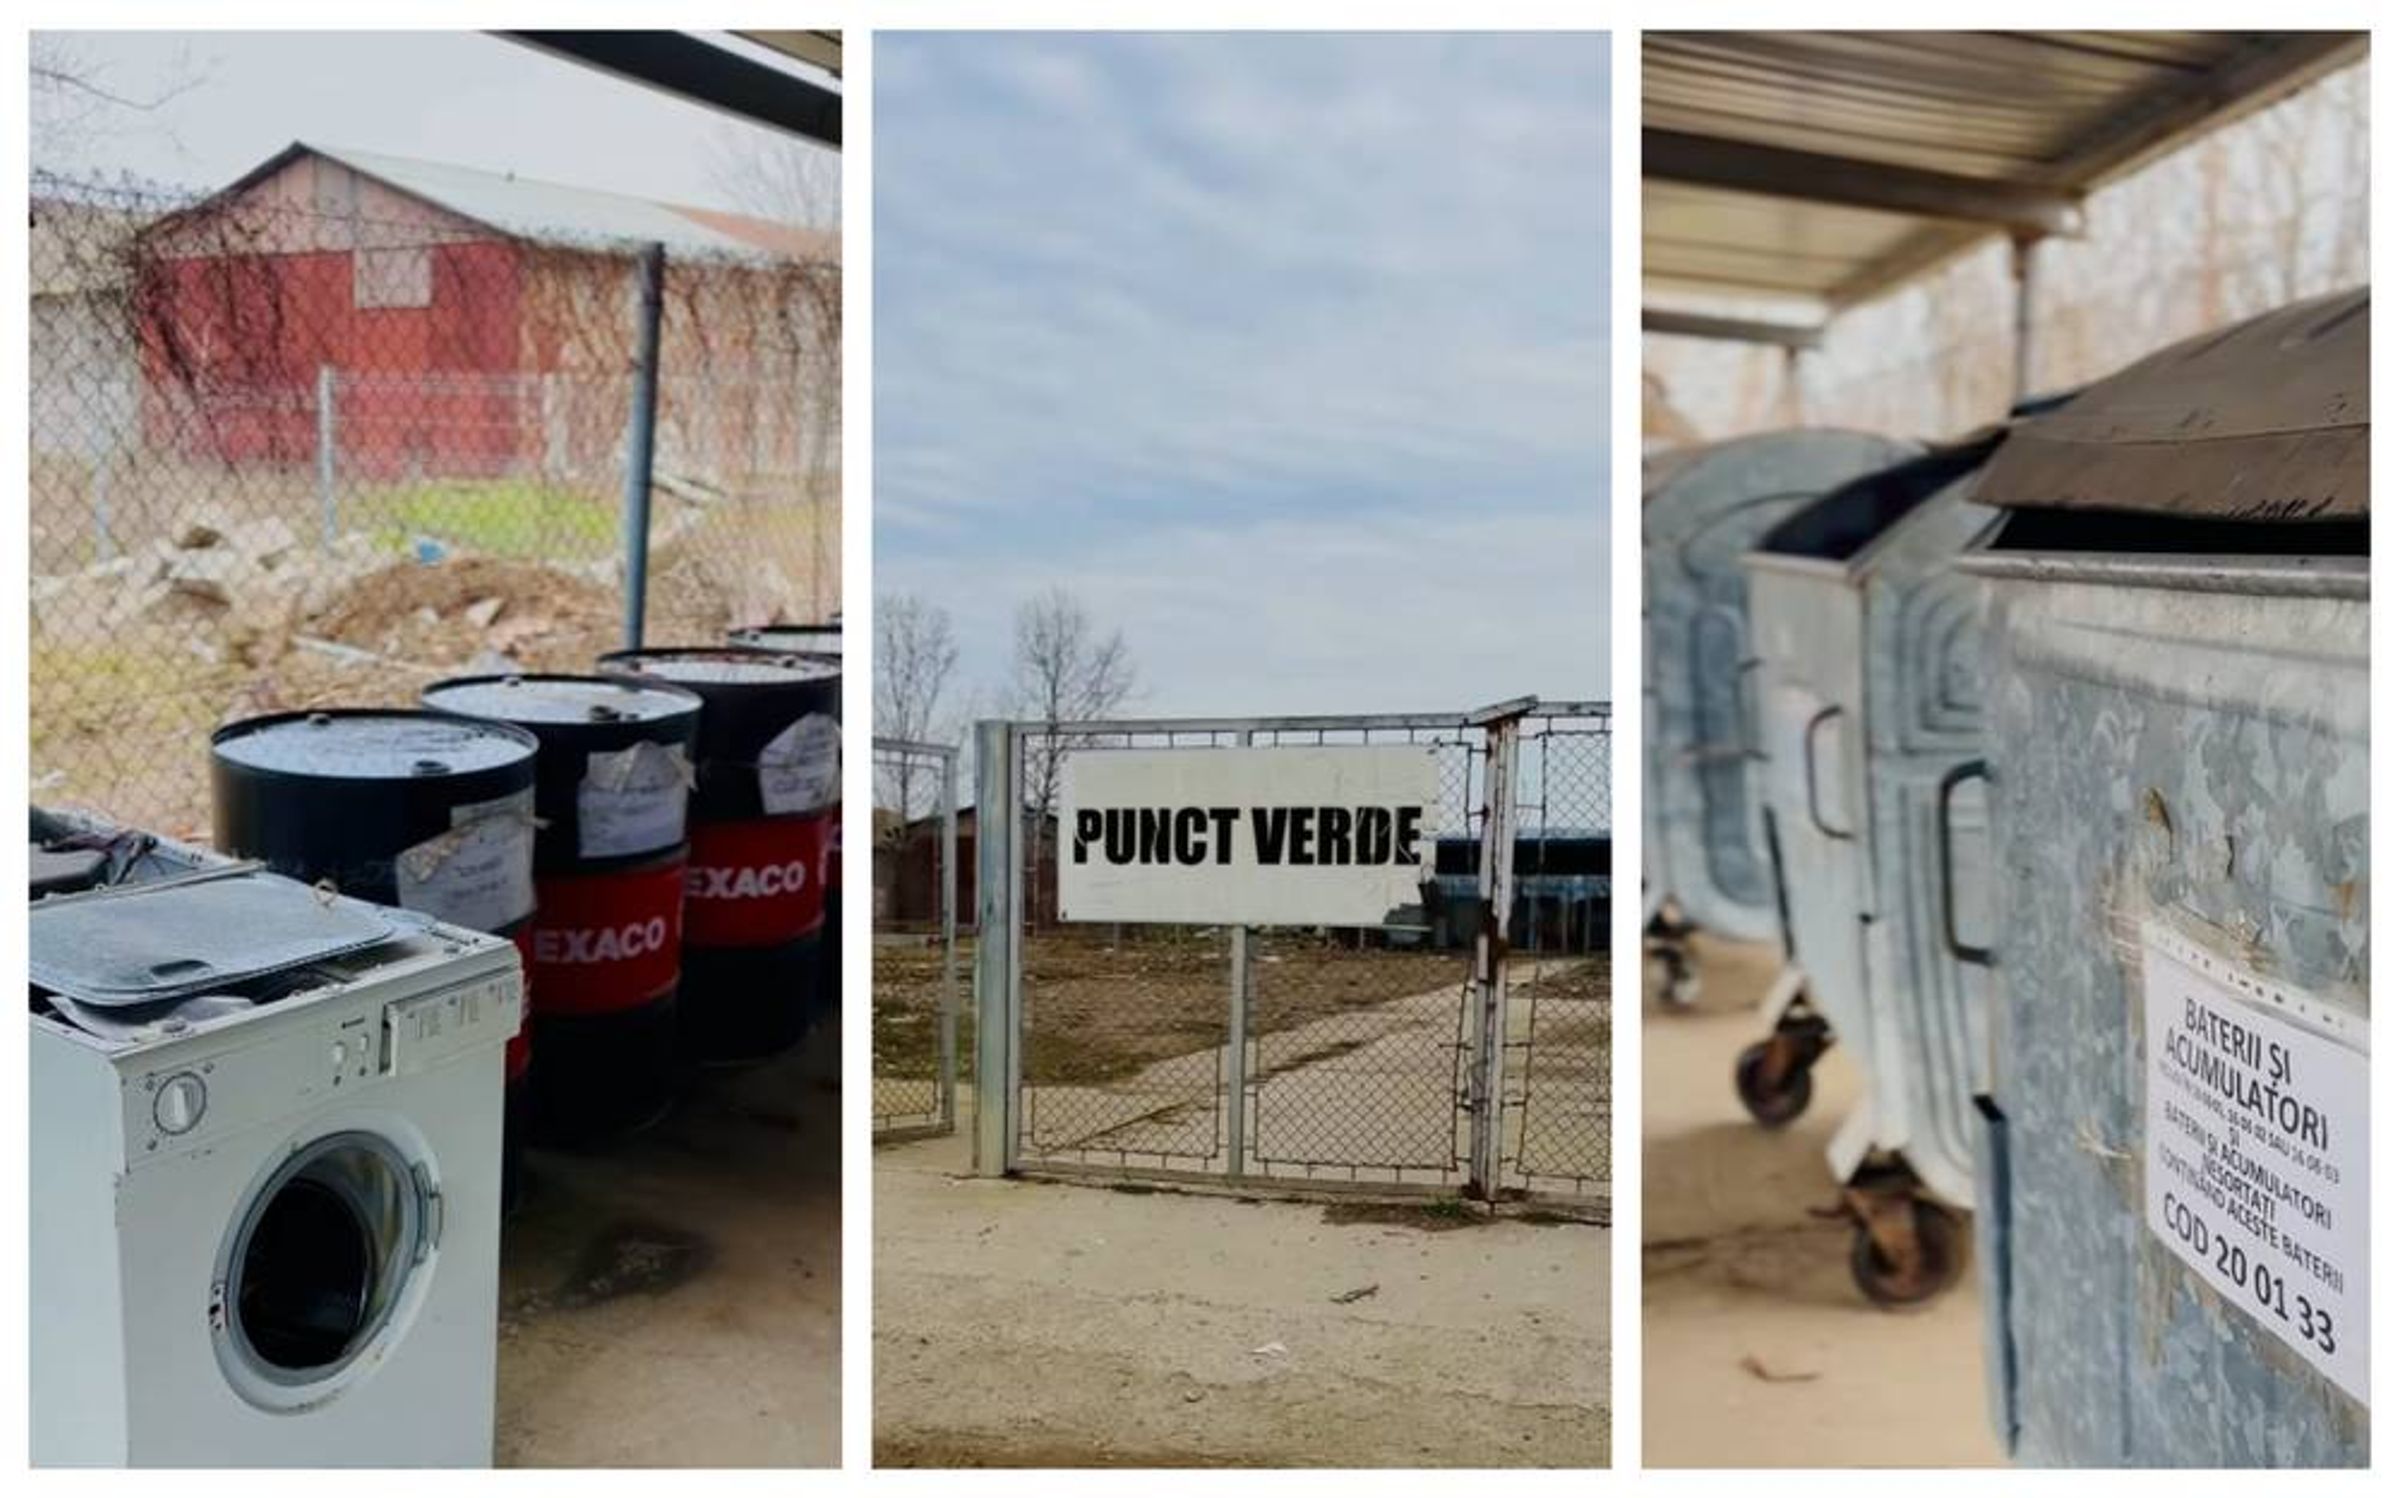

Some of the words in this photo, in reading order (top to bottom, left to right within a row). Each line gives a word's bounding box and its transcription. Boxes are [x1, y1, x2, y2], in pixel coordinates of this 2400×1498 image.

[1073, 806, 1240, 866] PUNCT
[1252, 805, 1422, 866] VERDE
[534, 916, 666, 963] EXACO
[2186, 998, 2262, 1072] BATERII
[2268, 1042, 2290, 1088] ȘI
[2165, 1027, 2327, 1152] ACUMULATORI
[2221, 1142, 2332, 1230] ACUMULATORI
[2163, 1191, 2209, 1257] COD
[2215, 1233, 2247, 1288] 20
[2255, 1263, 2289, 1322] 01
[2296, 1293, 2336, 1354] 33
[2227, 1198, 2279, 1249] ACESTE
[2282, 1233, 2344, 1295] BATERII
